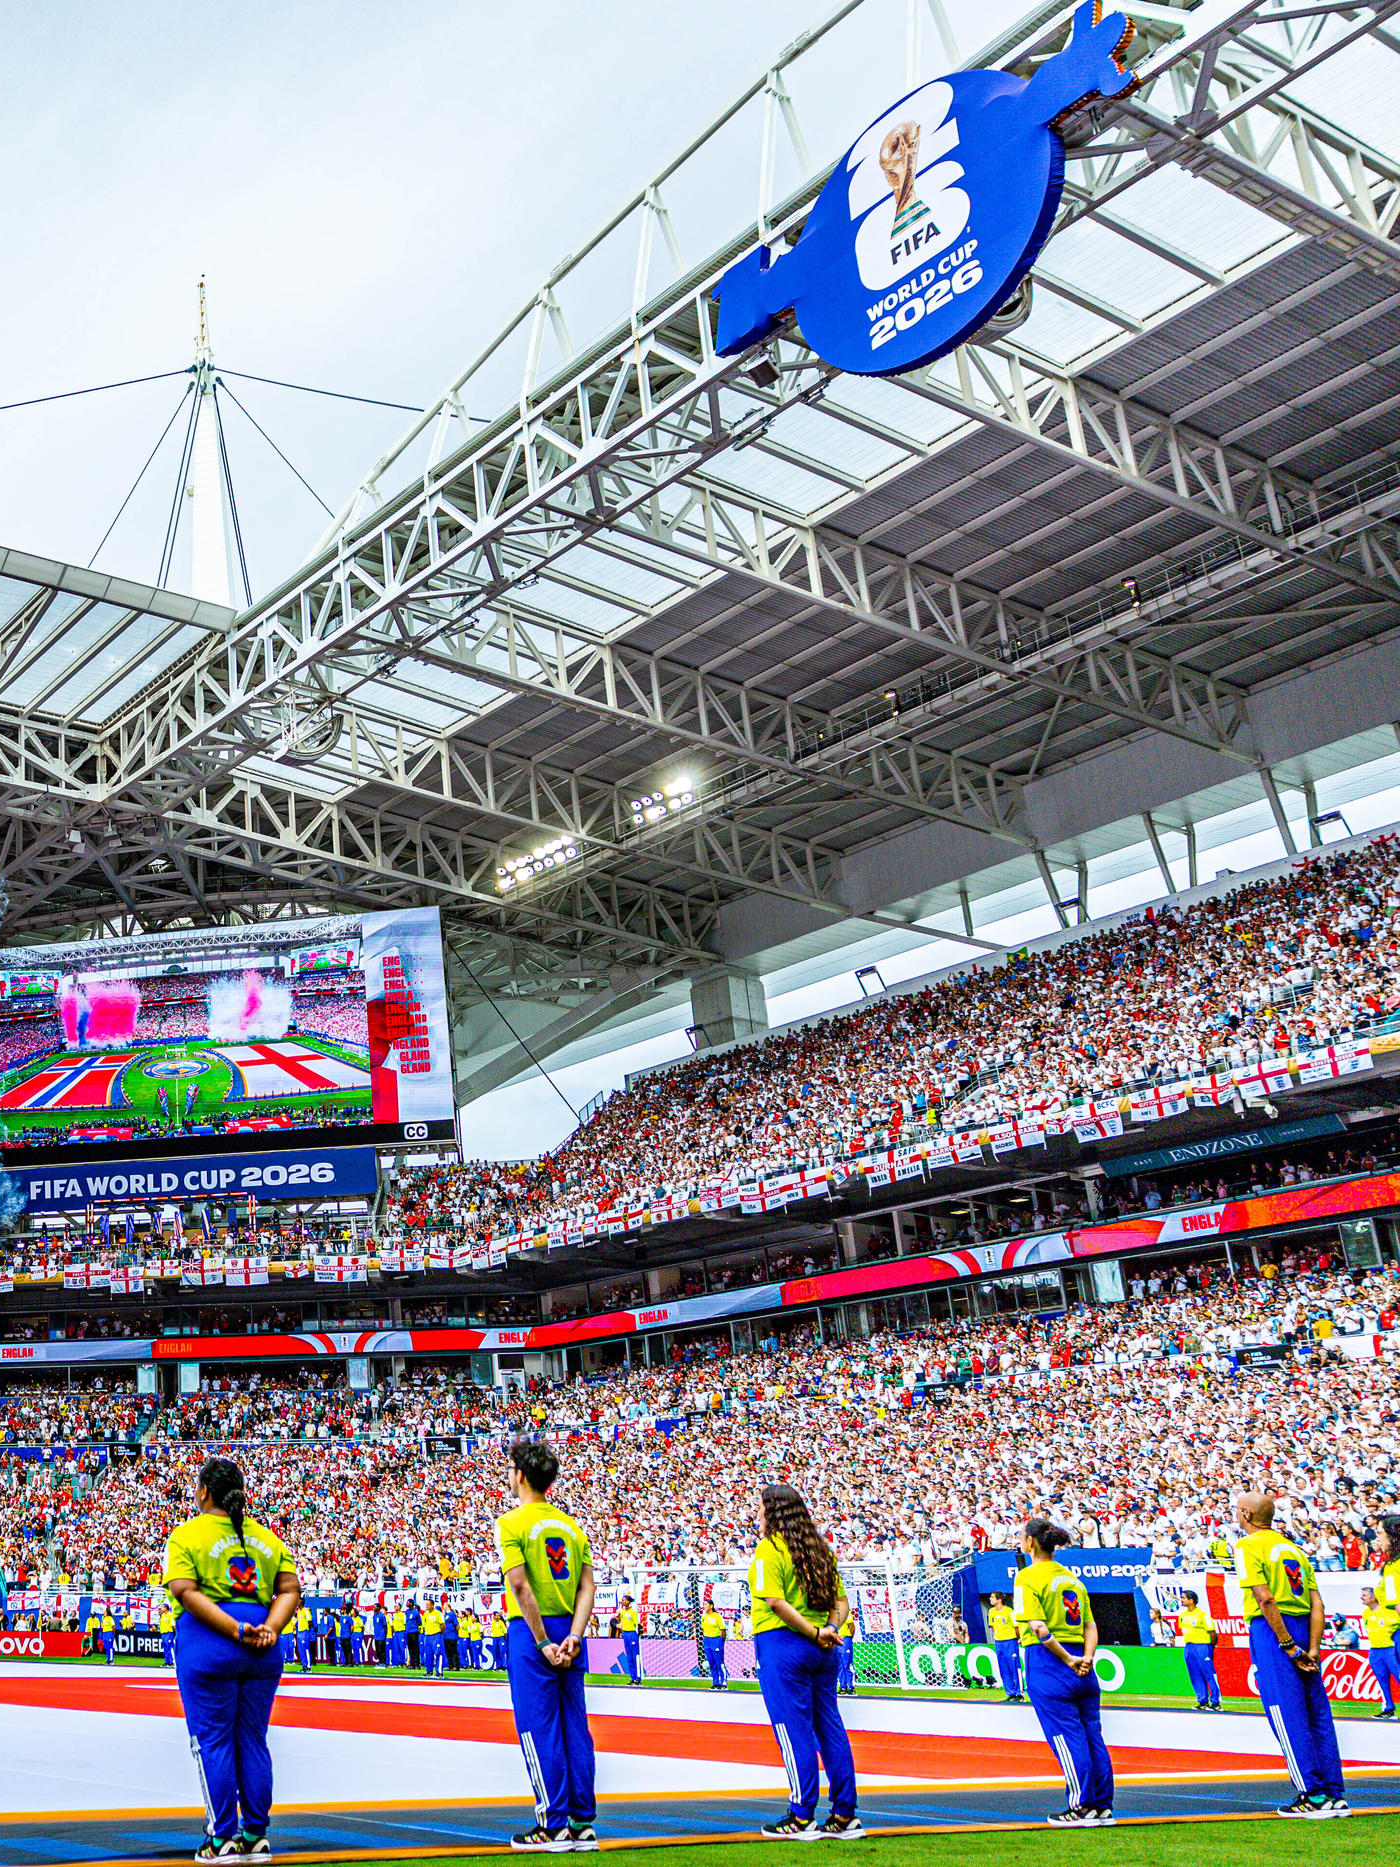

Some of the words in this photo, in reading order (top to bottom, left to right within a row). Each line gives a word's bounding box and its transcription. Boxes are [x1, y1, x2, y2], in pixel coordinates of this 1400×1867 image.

[890, 221, 941, 265] FIFA
[866, 268, 936, 322] WORLD
[937, 239, 978, 275] CUP
[869, 259, 983, 351] 2026
[382, 956, 400, 966] ENG
[383, 967, 406, 978] ENGL
[386, 1014, 427, 1027] ENGLAND
[387, 1026, 428, 1038] ENGLAND
[392, 1038, 429, 1050] NGLAND
[399, 1050, 430, 1062] GLAND
[400, 1062, 431, 1074] GLAND
[1096, 1099, 1115, 1110] BCFC
[405, 1124, 427, 1139] CC
[1018, 1125, 1039, 1135] RAMS
[898, 1145, 917, 1157] SAFC
[929, 1145, 960, 1156] BARROW
[961, 1140, 976, 1149] AFC
[1168, 1132, 1263, 1163] ENDZONE
[873, 1158, 911, 1172] DURHAM
[897, 1164, 921, 1177] AMELIA
[29, 1177, 80, 1200] FIFA
[87, 1172, 184, 1195] WORLD
[184, 1168, 235, 1191] CUP
[240, 1162, 335, 1188] 2026
[638, 1309, 668, 1325] ENGLAN
[1, 1347, 34, 1359] ENGLAN
[1082, 1564, 1110, 1578] CUP
